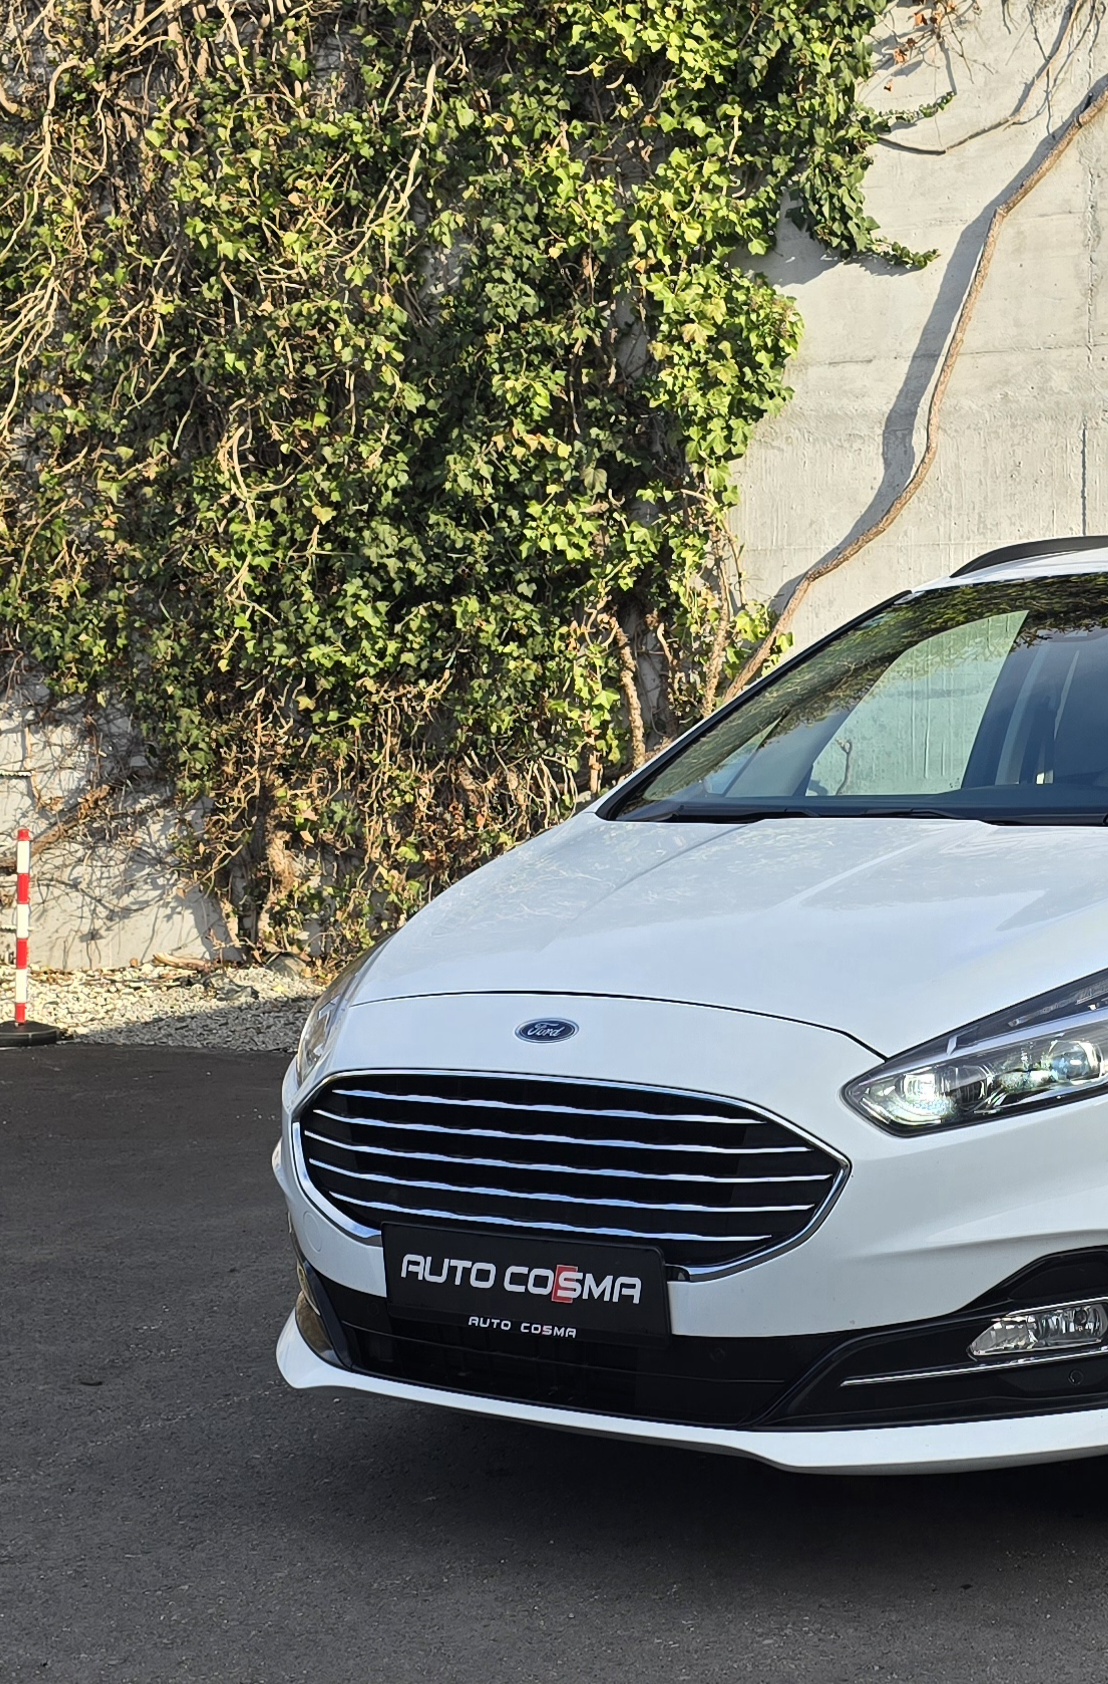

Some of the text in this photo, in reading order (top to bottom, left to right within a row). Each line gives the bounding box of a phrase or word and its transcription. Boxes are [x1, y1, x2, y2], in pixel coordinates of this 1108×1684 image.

[527, 1022, 565, 1037] Ford
[400, 1253, 642, 1304] AUTO COSMA
[468, 1316, 577, 1339] AUTO COSMA
